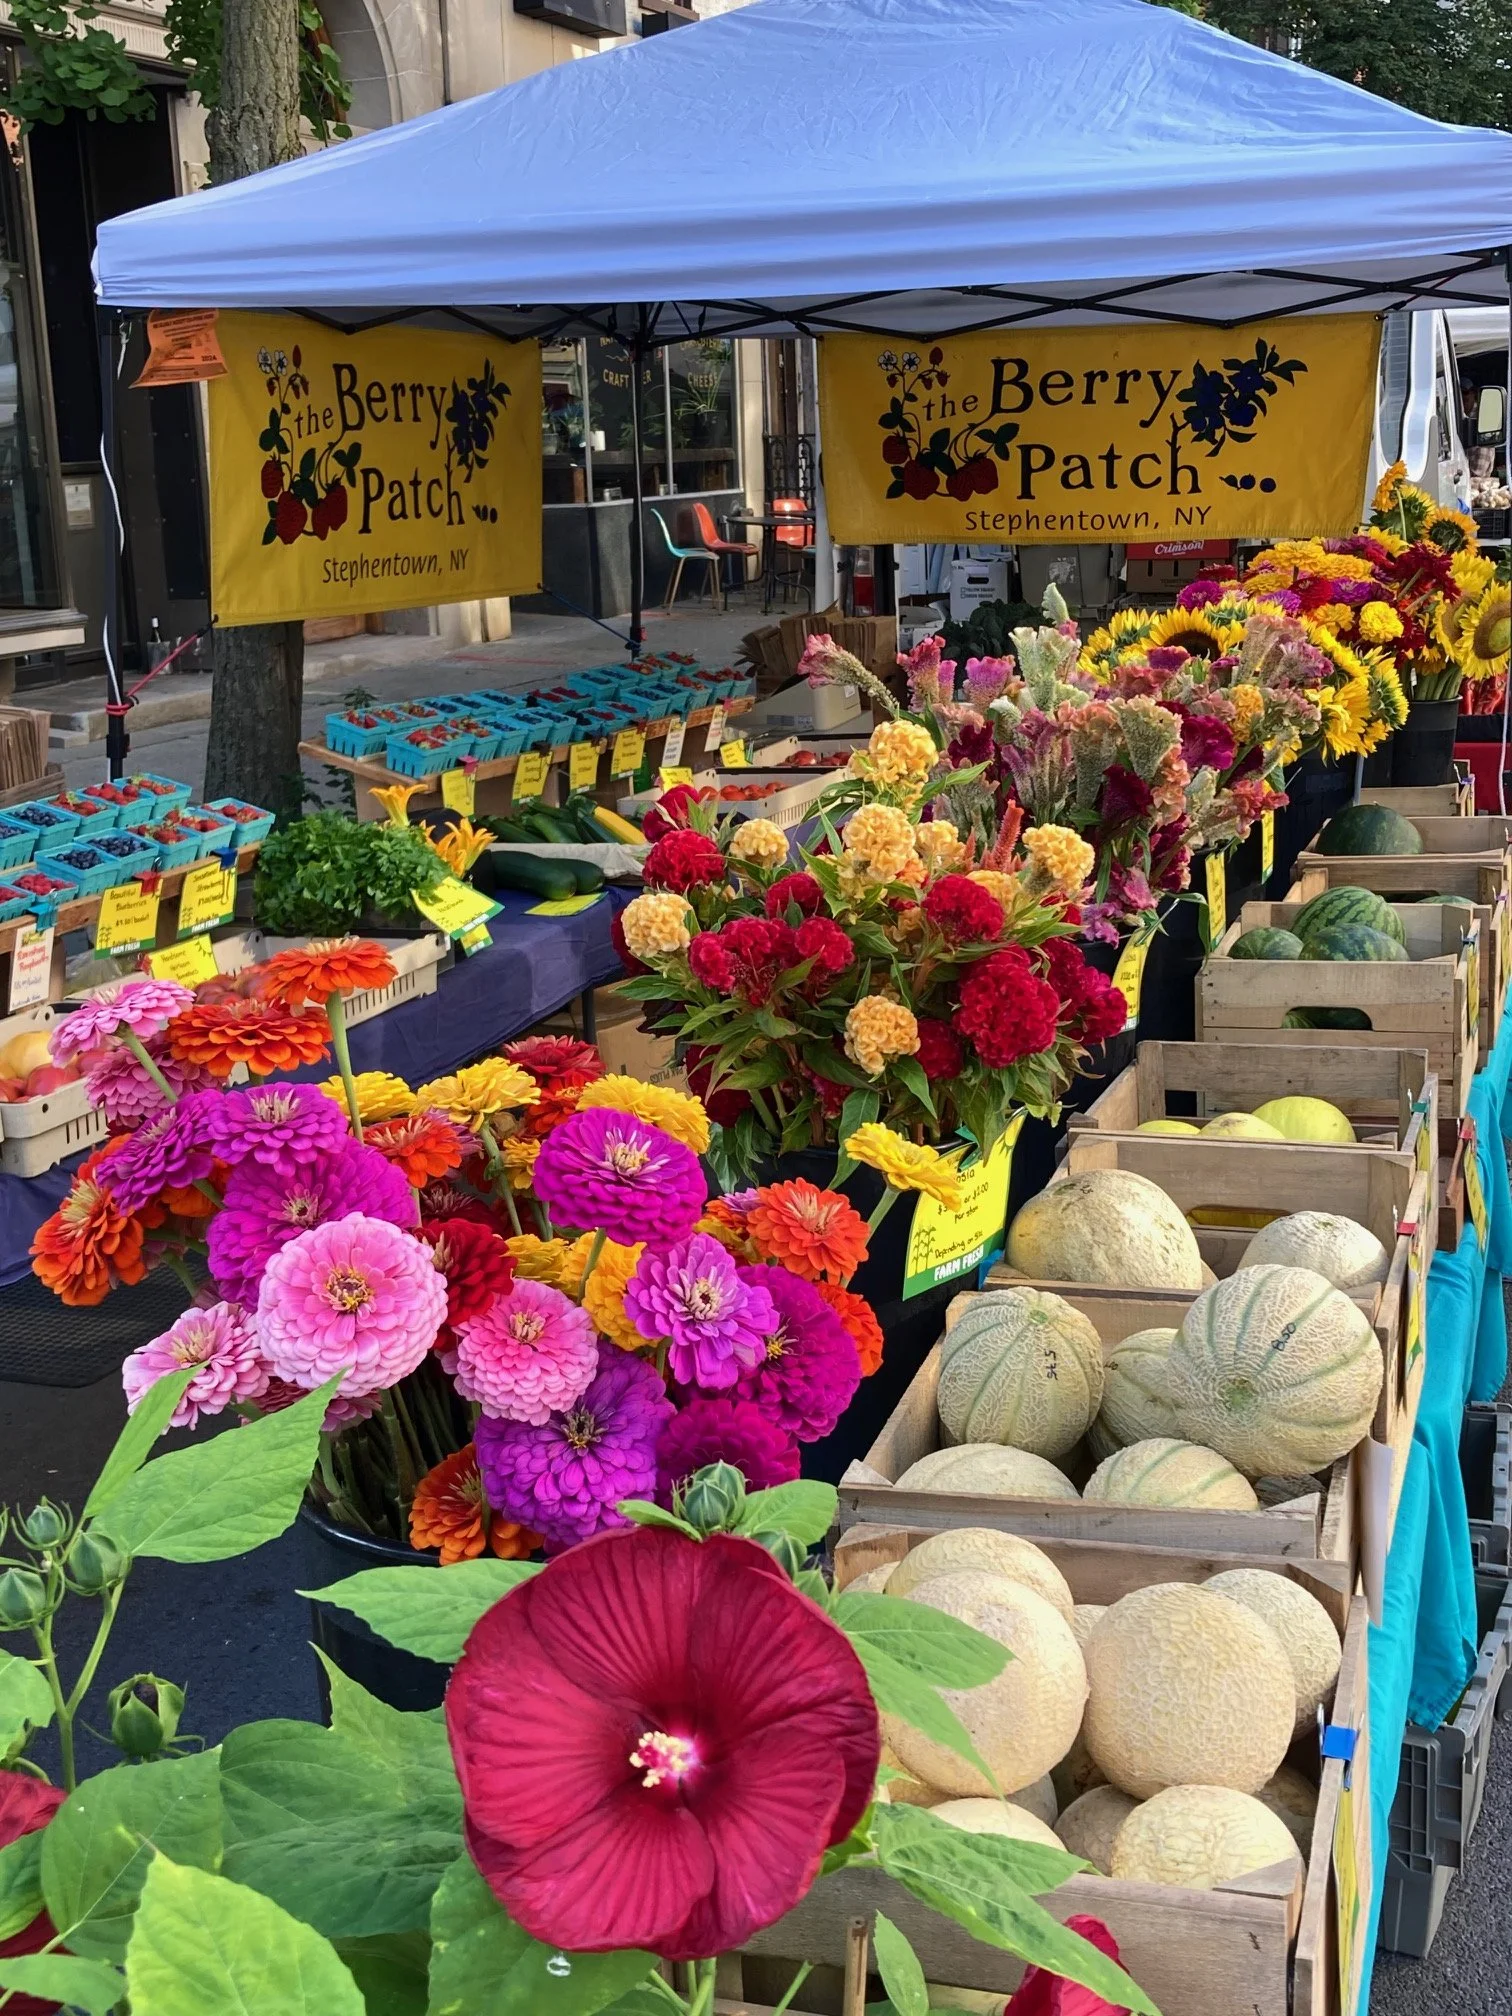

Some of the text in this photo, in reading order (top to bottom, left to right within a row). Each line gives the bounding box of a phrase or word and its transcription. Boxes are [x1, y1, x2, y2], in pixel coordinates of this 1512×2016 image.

[603, 368, 630, 389] CRAFT
[687, 372, 718, 388] CHEESE
[922, 357, 1182, 429] the Berry
[294, 363, 447, 450] the Berry
[1016, 435, 1202, 500] Patch
[358, 455, 465, 534] Patch
[965, 505, 1212, 535] Stephentown, NY
[1154, 541, 1204, 555] Crimson
[323, 548, 469, 588] Stephentown, NY
[934, 1240, 966, 1259] Depending
[934, 1243, 984, 1282] FARM FRESH
